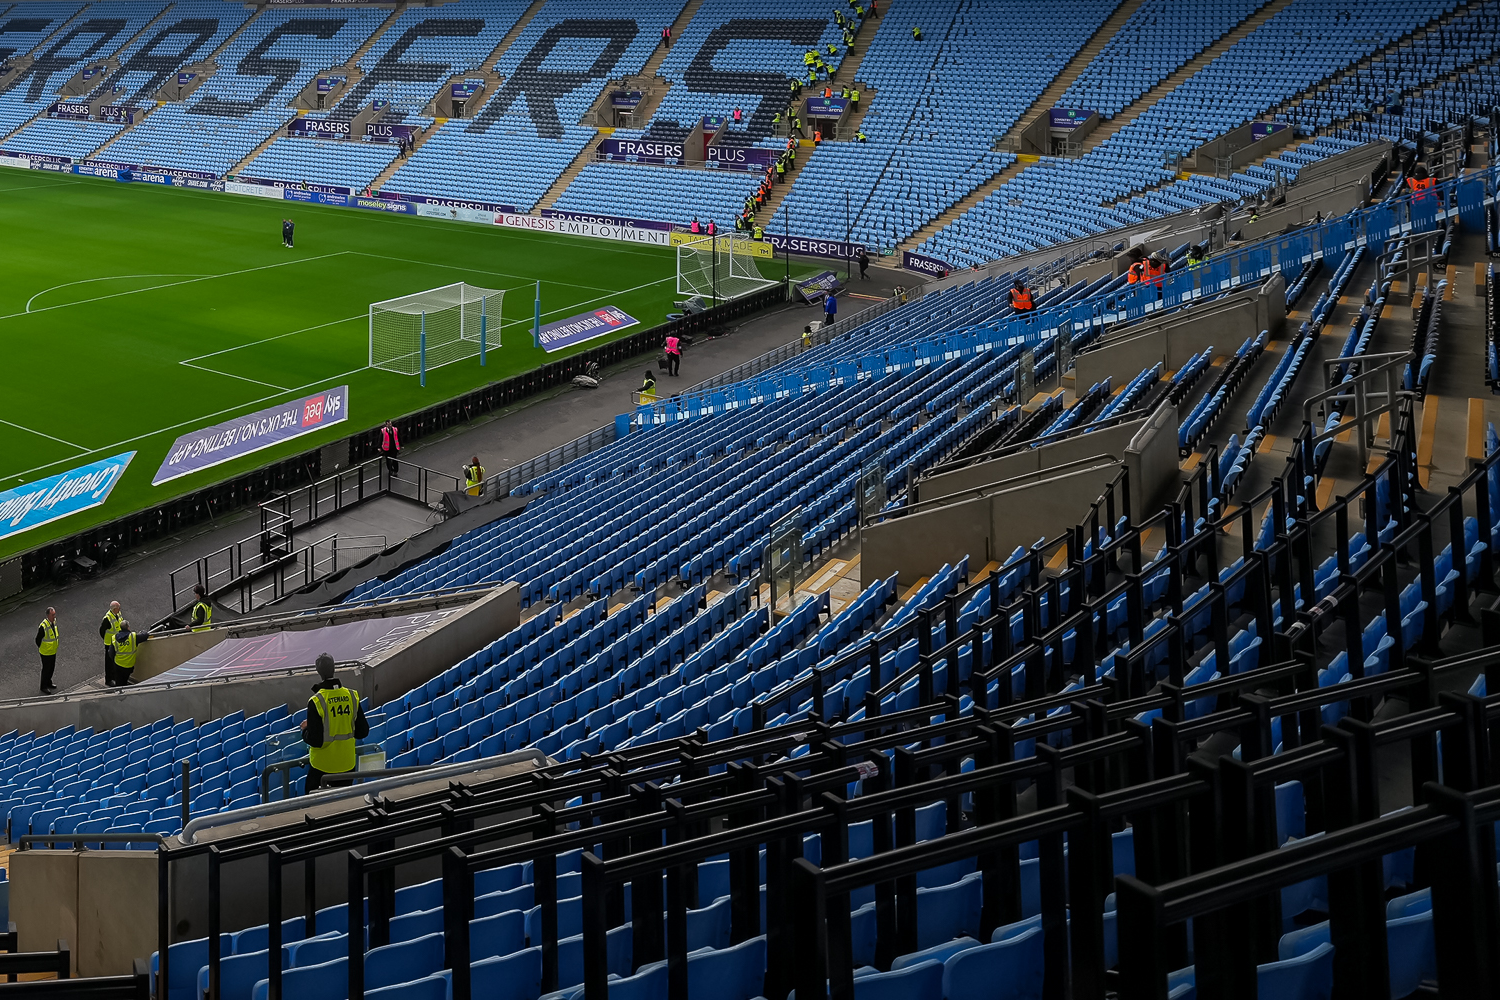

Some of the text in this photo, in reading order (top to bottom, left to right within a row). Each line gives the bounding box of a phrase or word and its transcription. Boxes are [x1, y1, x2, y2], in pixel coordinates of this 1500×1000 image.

[57, 104, 119, 117] FRASERS PLUS
[305, 120, 392, 137] FRASERS PLUS
[618, 142, 745, 162] FRASERS PLUS
[94, 167, 118, 178] arena
[142, 173, 165, 184] arena
[225, 183, 263, 195] SHOTCRETE
[505, 215, 668, 244] GENESIS EMPLOYMENT
[763, 236, 864, 259] FRASERSPLUS
[909, 257, 944, 273] FRASERSP
[303, 402, 322, 422] bet
[323, 394, 341, 417] sky
[282, 408, 299, 427] THE
[193, 427, 236, 459] BETTING
[169, 440, 196, 466] APP
[34, 463, 120, 511] Coventry
[328, 695, 350, 705] STEWARD
[330, 704, 351, 718] 144
